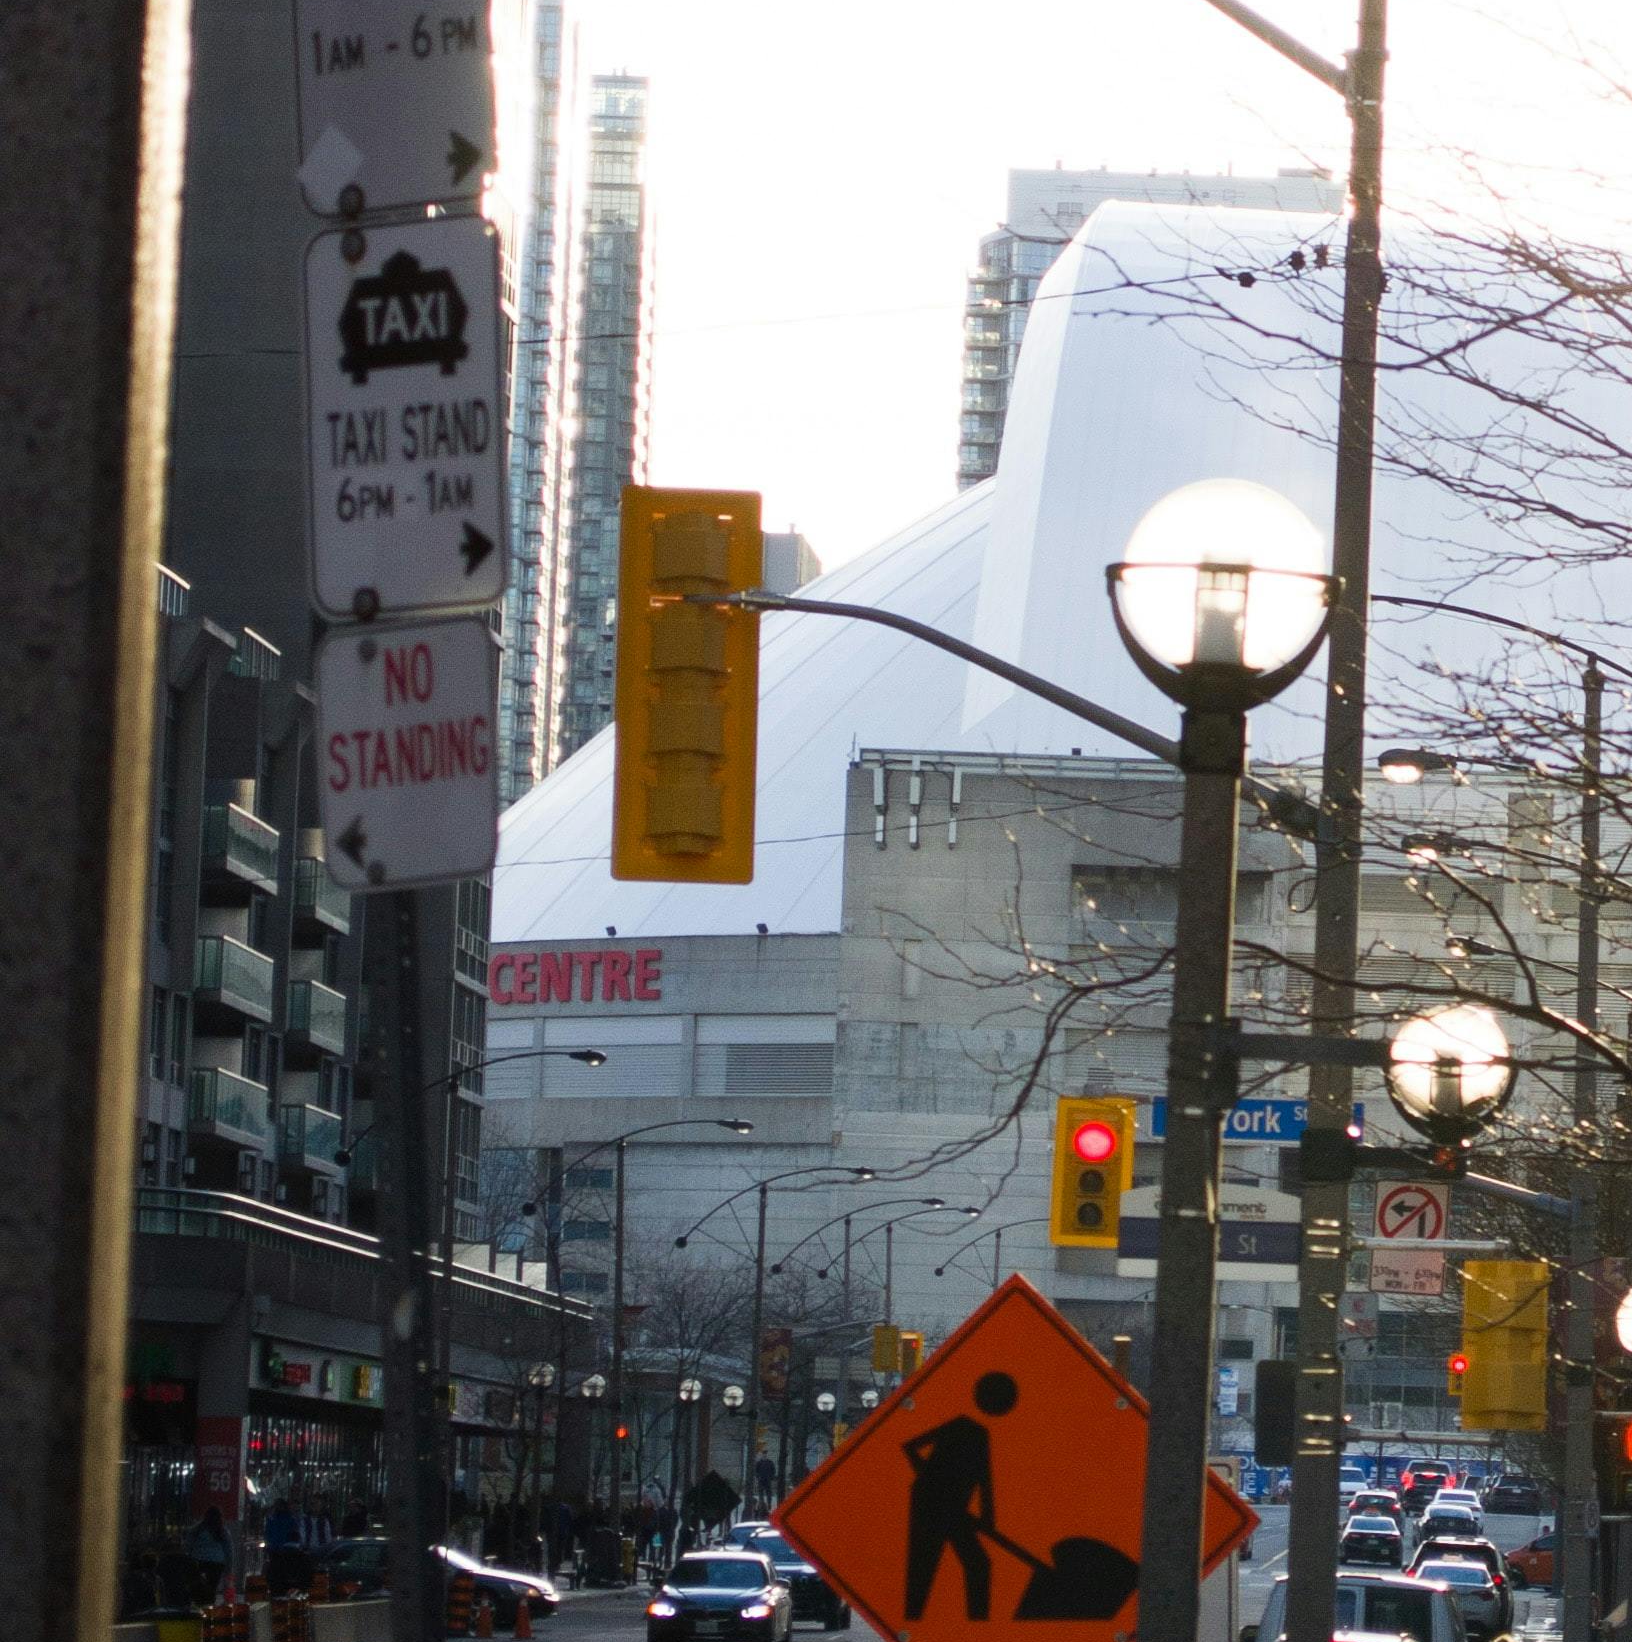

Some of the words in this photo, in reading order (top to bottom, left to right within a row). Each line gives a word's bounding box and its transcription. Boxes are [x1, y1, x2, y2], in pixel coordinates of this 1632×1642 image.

[358, 292, 448, 347] TAXI
[328, 411, 387, 468] TAXI
[403, 400, 490, 460] STAND
[337, 477, 394, 523] 6PM
[425, 469, 473, 515] 1AM
[384, 644, 434, 707] NO
[329, 717, 488, 793] STANDING
[488, 949, 661, 1004] CENTRE
[1238, 1235, 1258, 1255] St
